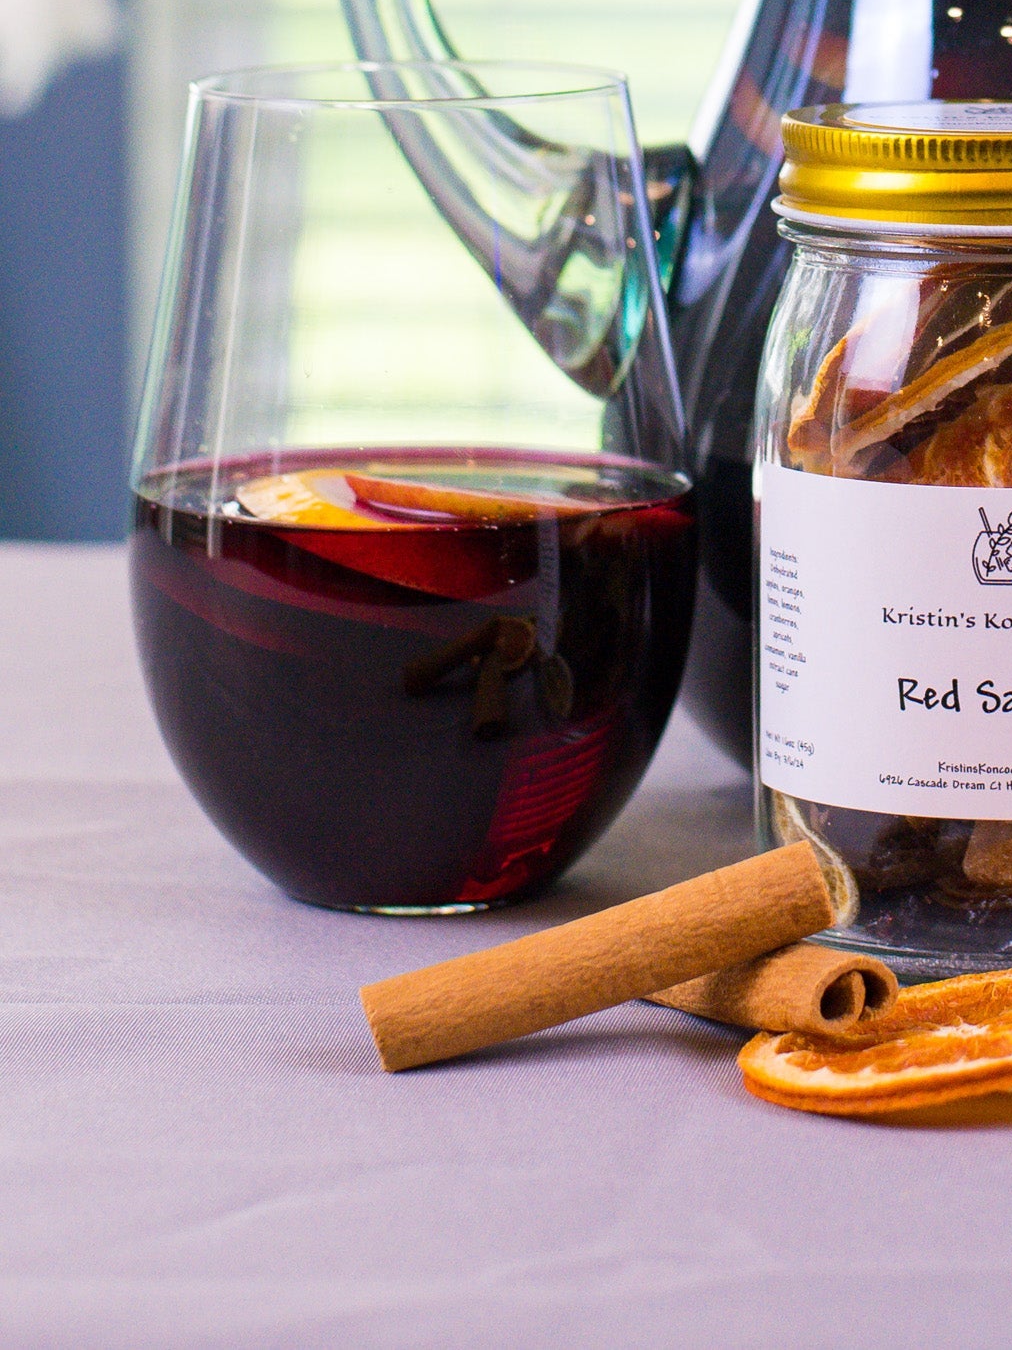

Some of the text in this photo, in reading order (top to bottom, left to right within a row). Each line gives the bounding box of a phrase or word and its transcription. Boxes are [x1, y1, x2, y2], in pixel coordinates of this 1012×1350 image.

[882, 606, 976, 628] Kristin's
[897, 678, 960, 713] Red
[797, 740, 815, 756] (45g)
[879, 774, 904, 785] 6926
[907, 777, 948, 789] Cascade
[952, 780, 986, 790] Dream
[989, 781, 1002, 790] Ct
